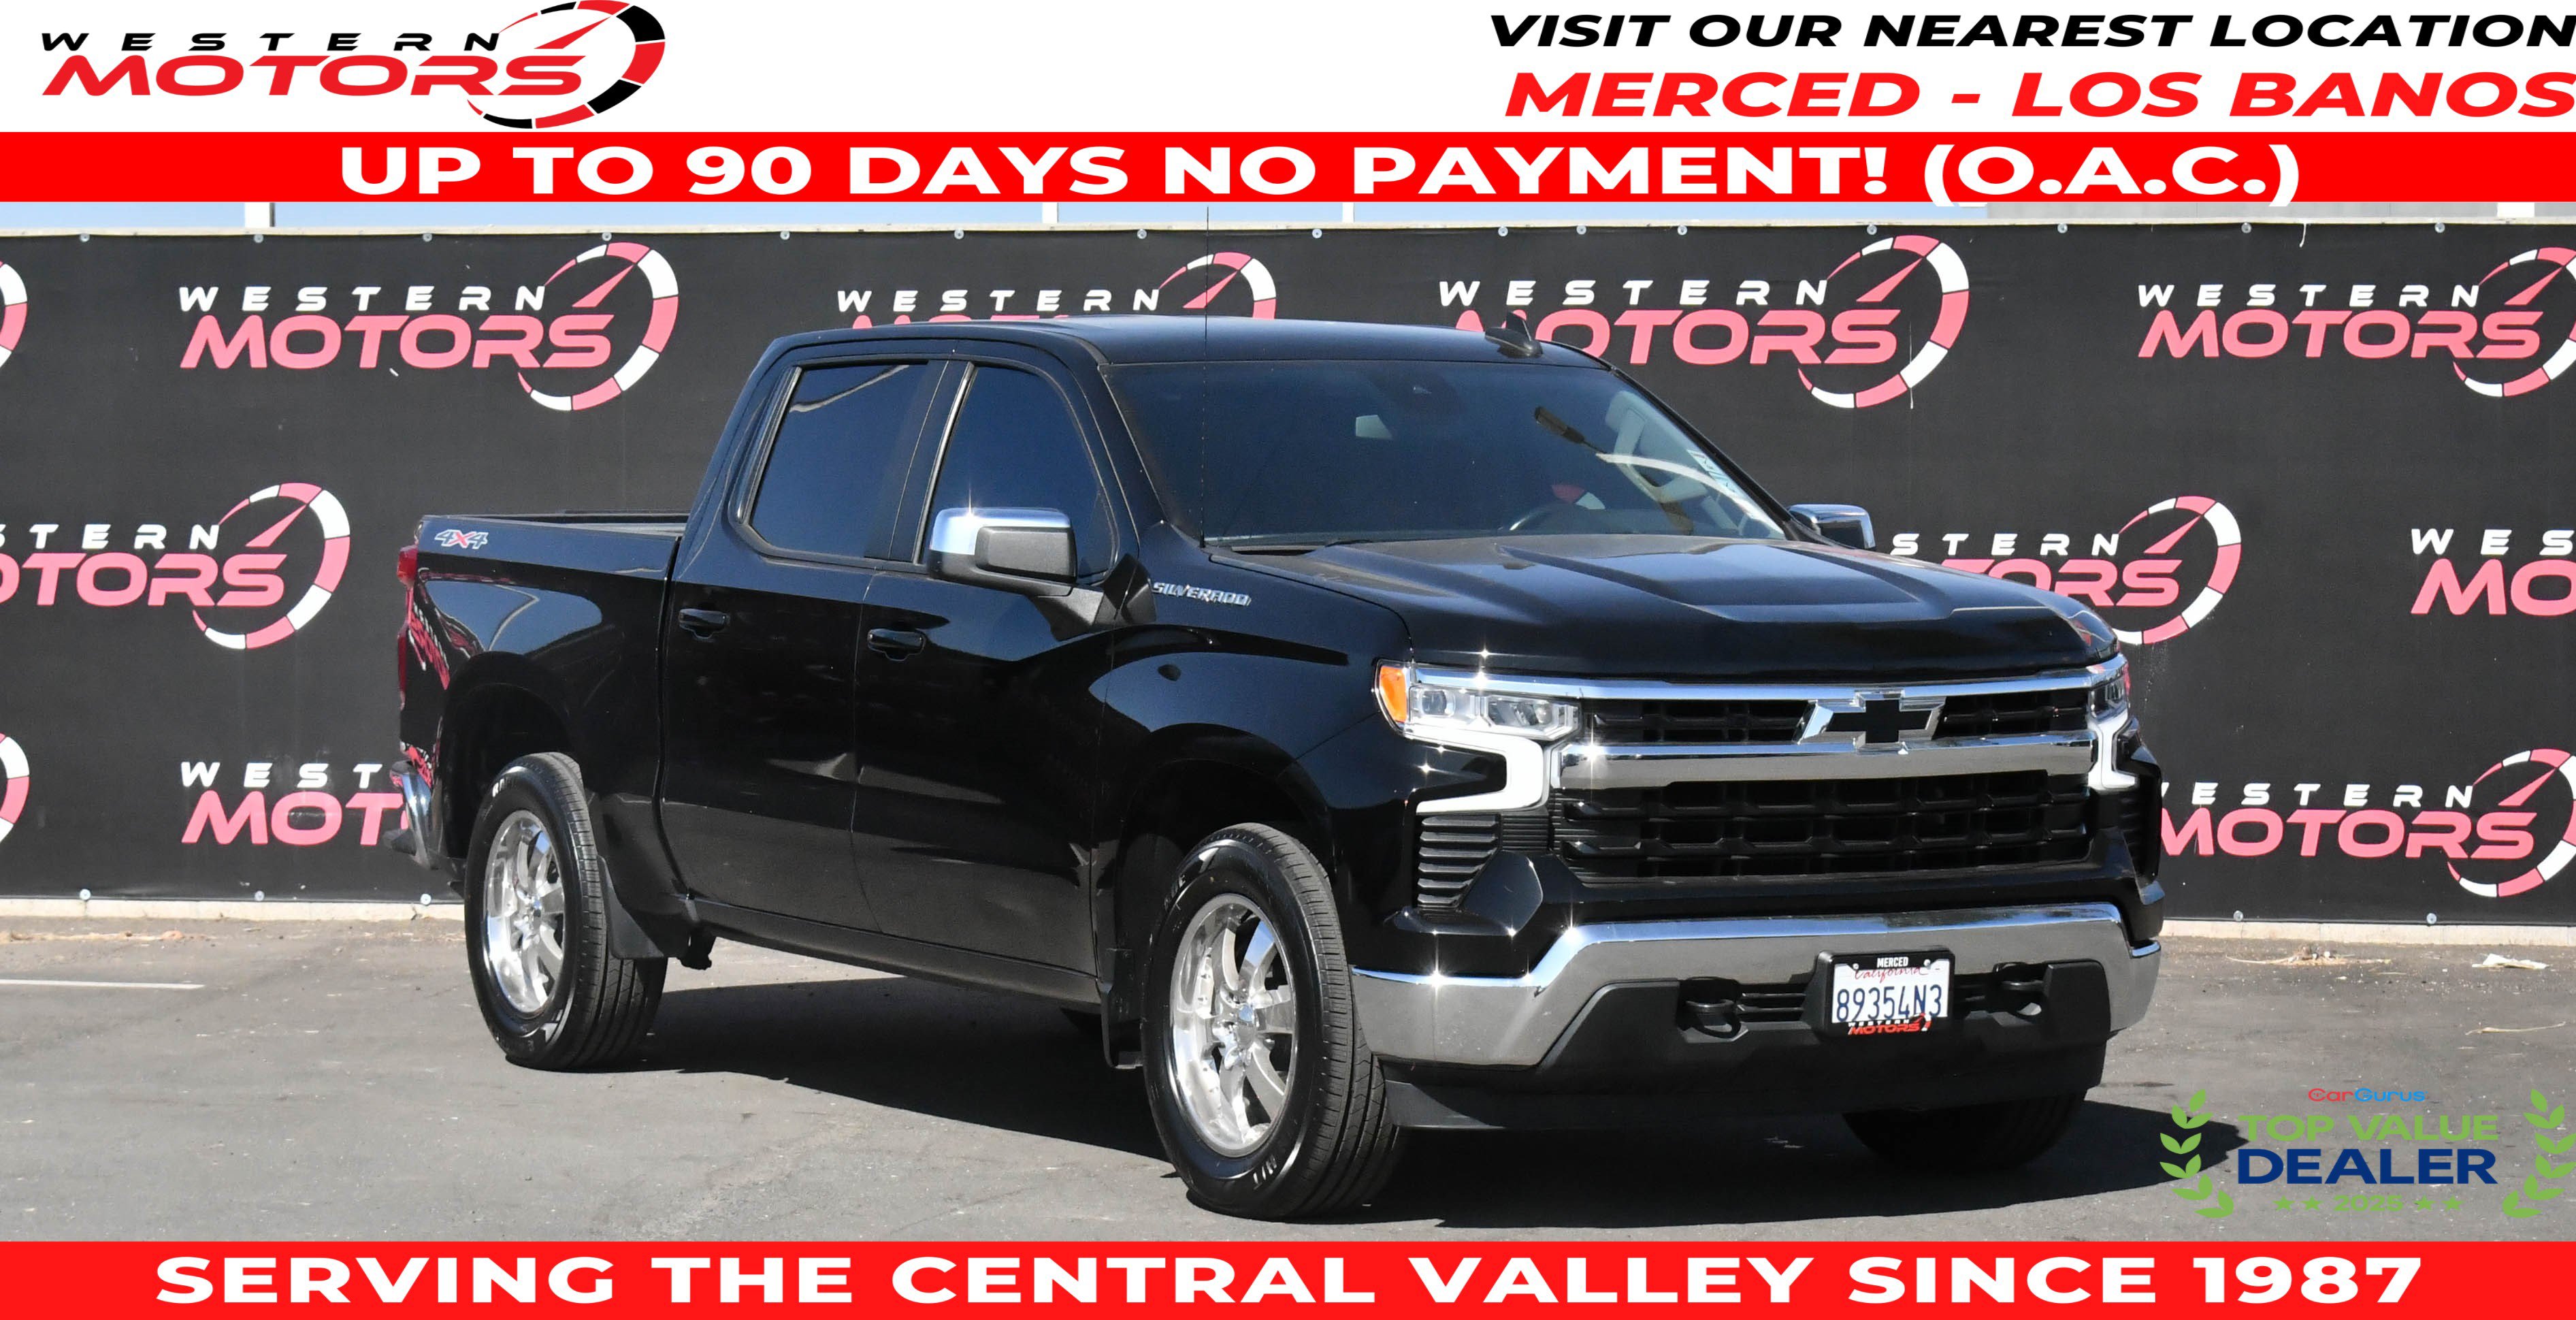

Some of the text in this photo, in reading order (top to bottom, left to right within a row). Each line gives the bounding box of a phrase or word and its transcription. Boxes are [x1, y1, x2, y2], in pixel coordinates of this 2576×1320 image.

[180, 285, 547, 311] WESTERN
[837, 289, 1160, 312] WESTERN
[1439, 280, 1828, 306] WESTERN
[2138, 284, 2479, 308] WESTERN
[180, 315, 615, 369] MOTORS
[2138, 309, 2543, 359] MOTORS
[0, 524, 220, 549] TERN
[2411, 528, 2575, 556] WES
[0, 552, 288, 607] TORS
[2411, 558, 2576, 616] MO
[1152, 582, 1252, 606] SILVERADO
[181, 761, 383, 789] WEST
[2162, 782, 2477, 808] ESTERN
[181, 790, 408, 846] MOT
[2162, 807, 2537, 859] MOTORS
[1876, 956, 1909, 968] MERCED
[1836, 984, 1942, 1022] 89354N3
[1847, 1023, 1921, 1035] MOTORS
